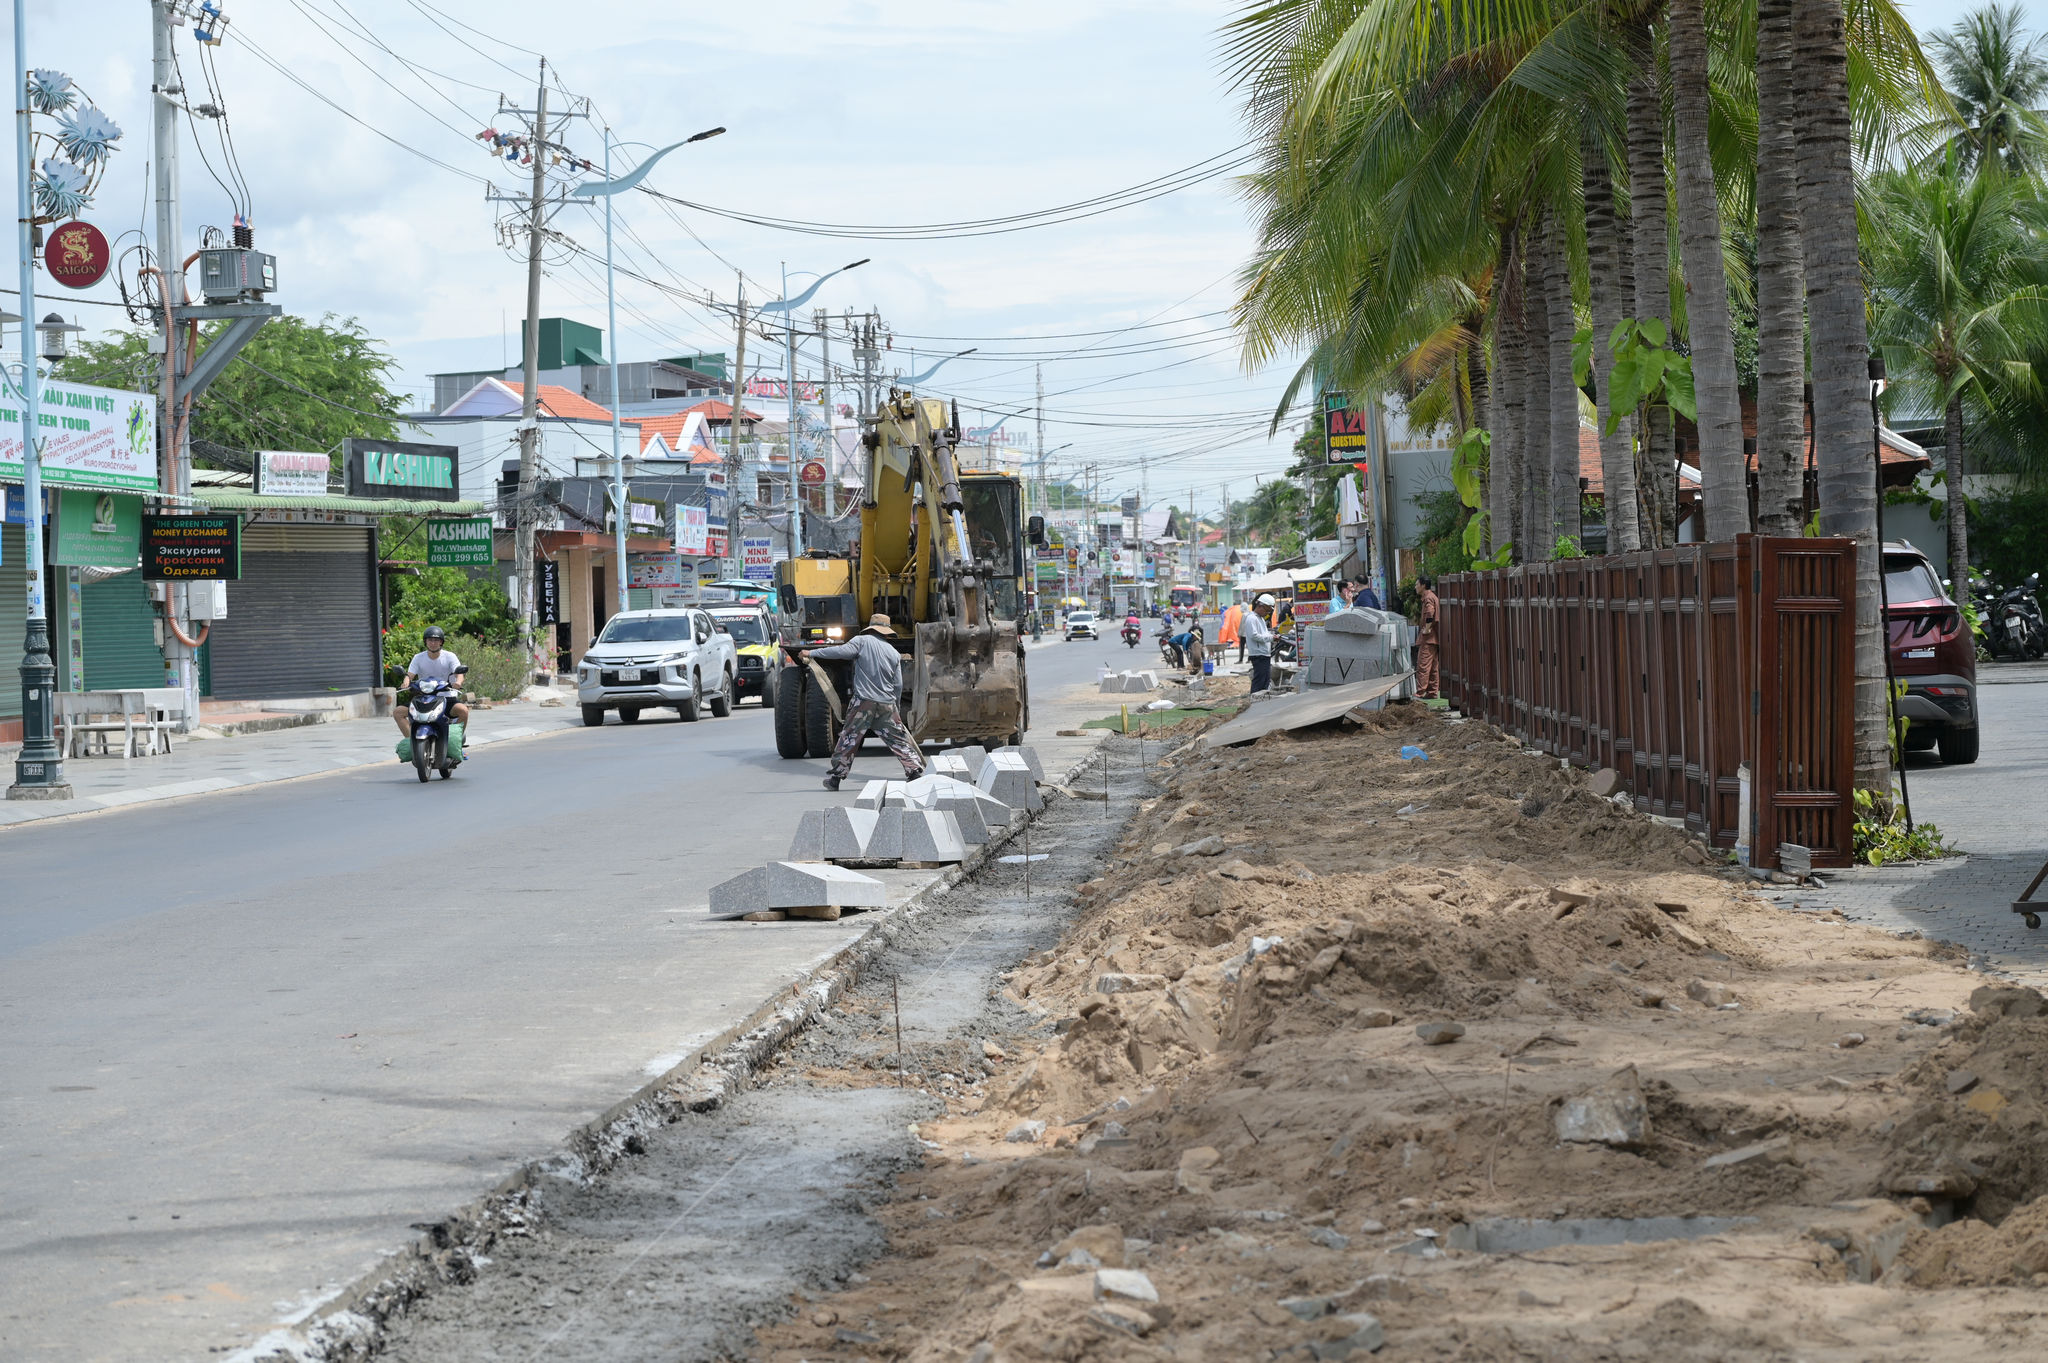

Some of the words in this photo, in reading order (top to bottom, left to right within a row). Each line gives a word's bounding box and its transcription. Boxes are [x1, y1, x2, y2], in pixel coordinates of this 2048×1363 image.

[56, 264, 97, 275] SAIGON
[66, 392, 92, 410] XANH
[94, 395, 115, 415] VIỆT
[0, 408, 18, 424] THE
[60, 416, 91, 432] TOUR
[1330, 434, 1366, 447] GUESTHOU
[364, 451, 453, 488] KASHMIR
[153, 528, 181, 536] MONEY
[183, 528, 227, 536] EXCHANGE
[428, 522, 490, 541] KASHMIR
[159, 546, 221, 556] Экскурсии
[433, 544, 487, 552] Tel/WhatsApp
[155, 555, 225, 566] Кроссовки
[431, 554, 451, 562] 0931
[455, 554, 471, 562] 299
[473, 553, 489, 561] 655
[745, 556, 771, 564] KHANG
[163, 566, 217, 576] Одежда
[1297, 581, 1327, 593] SPA
[544, 564, 555, 622] УЗБЕЧКА
